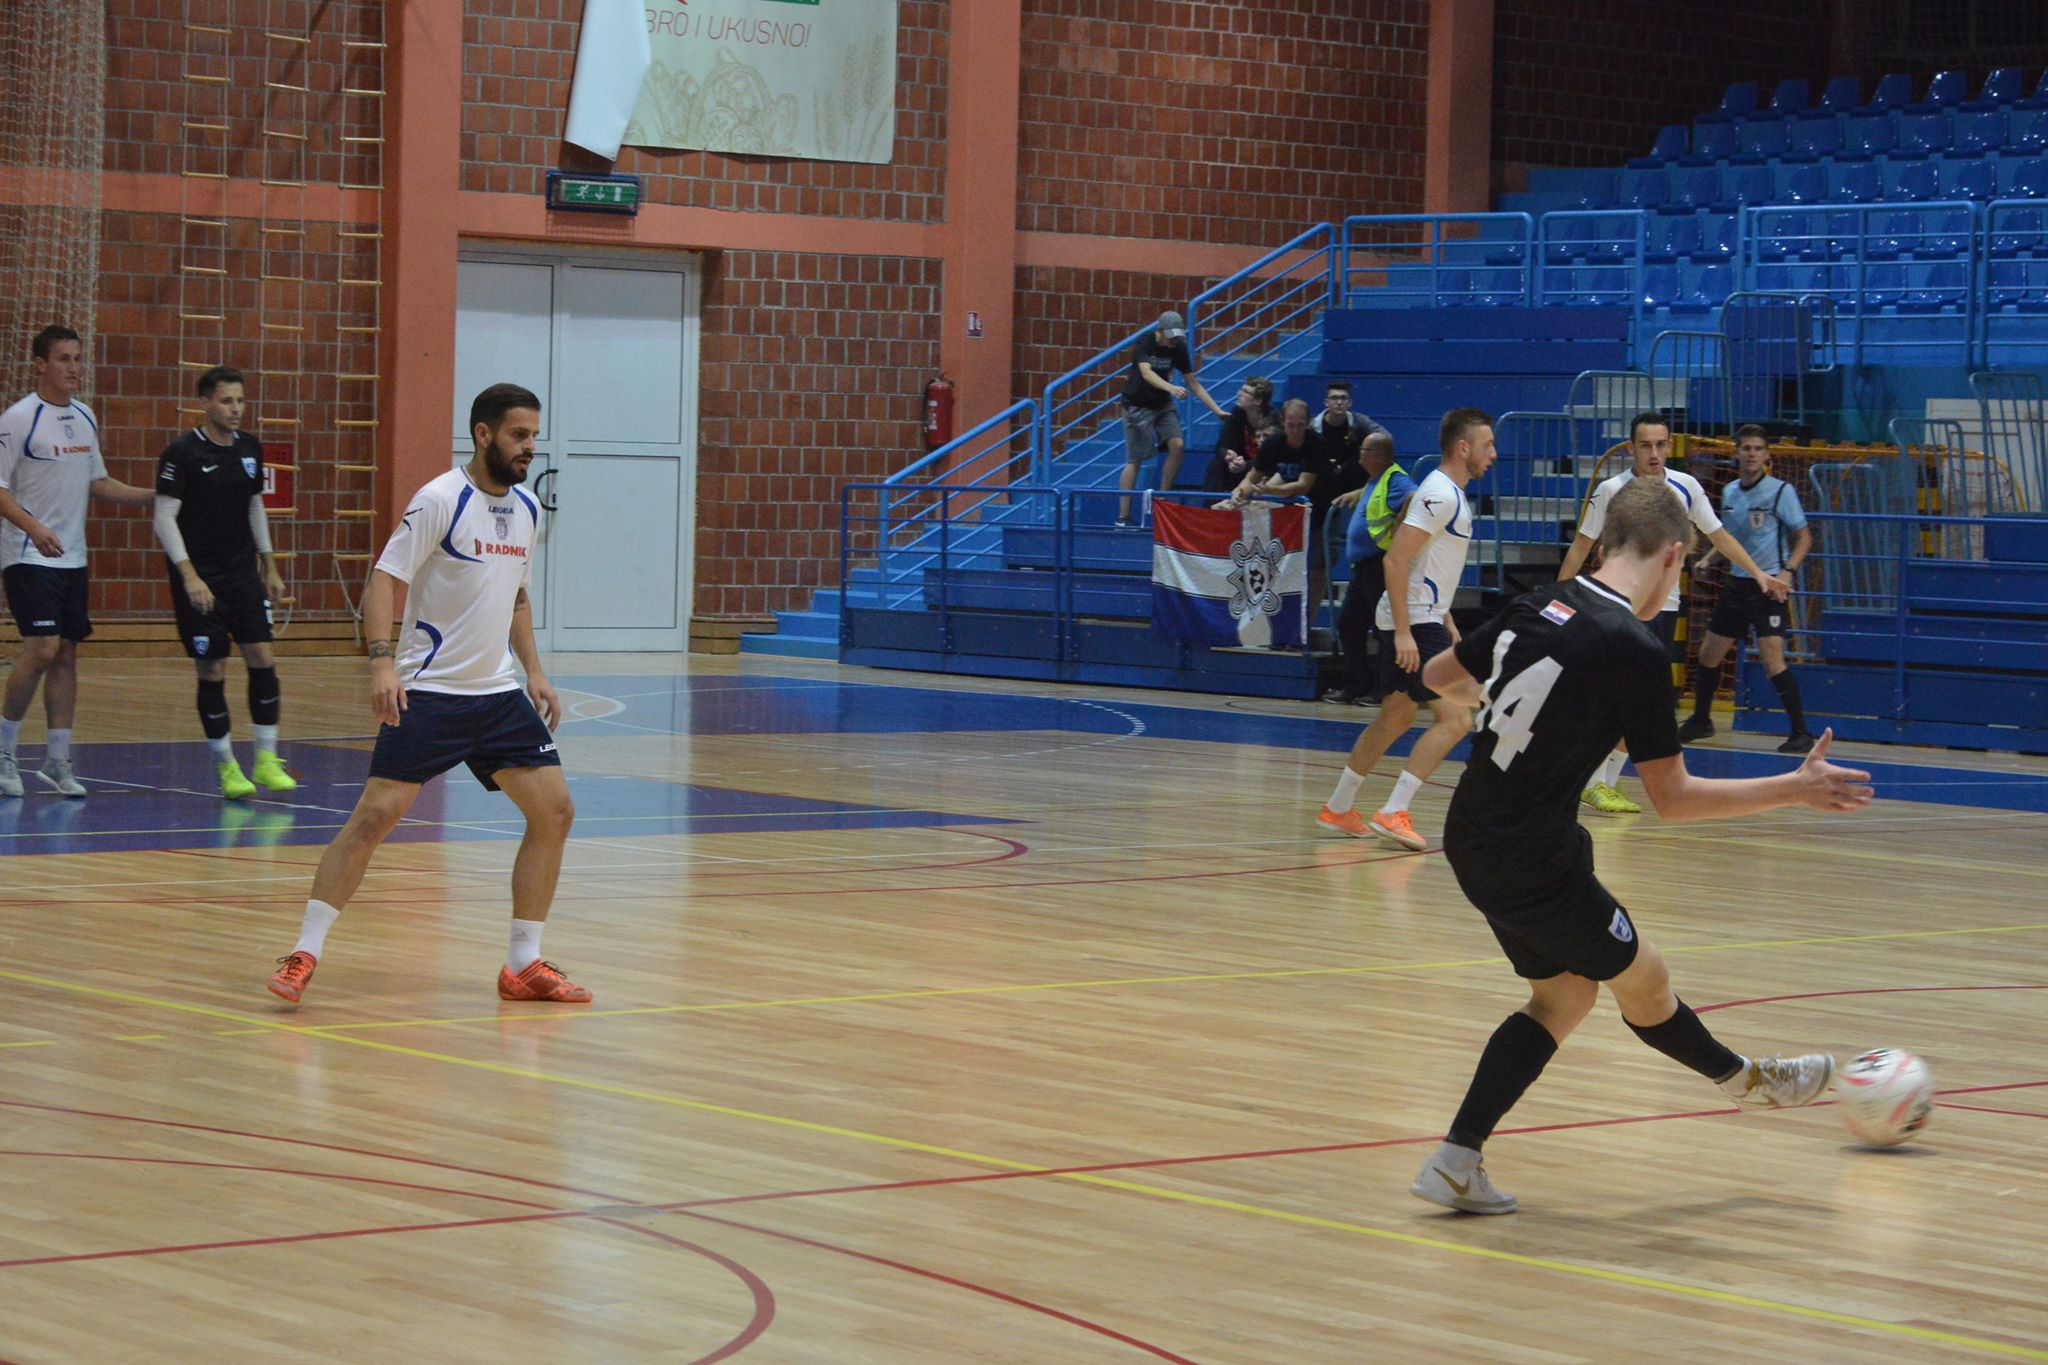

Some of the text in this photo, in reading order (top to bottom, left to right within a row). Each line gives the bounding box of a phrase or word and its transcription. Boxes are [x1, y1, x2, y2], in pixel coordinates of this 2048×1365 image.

[694, 14, 703, 37] I
[707, 15, 812, 48] UKUSNO!
[485, 543, 527, 558] RADNIK
